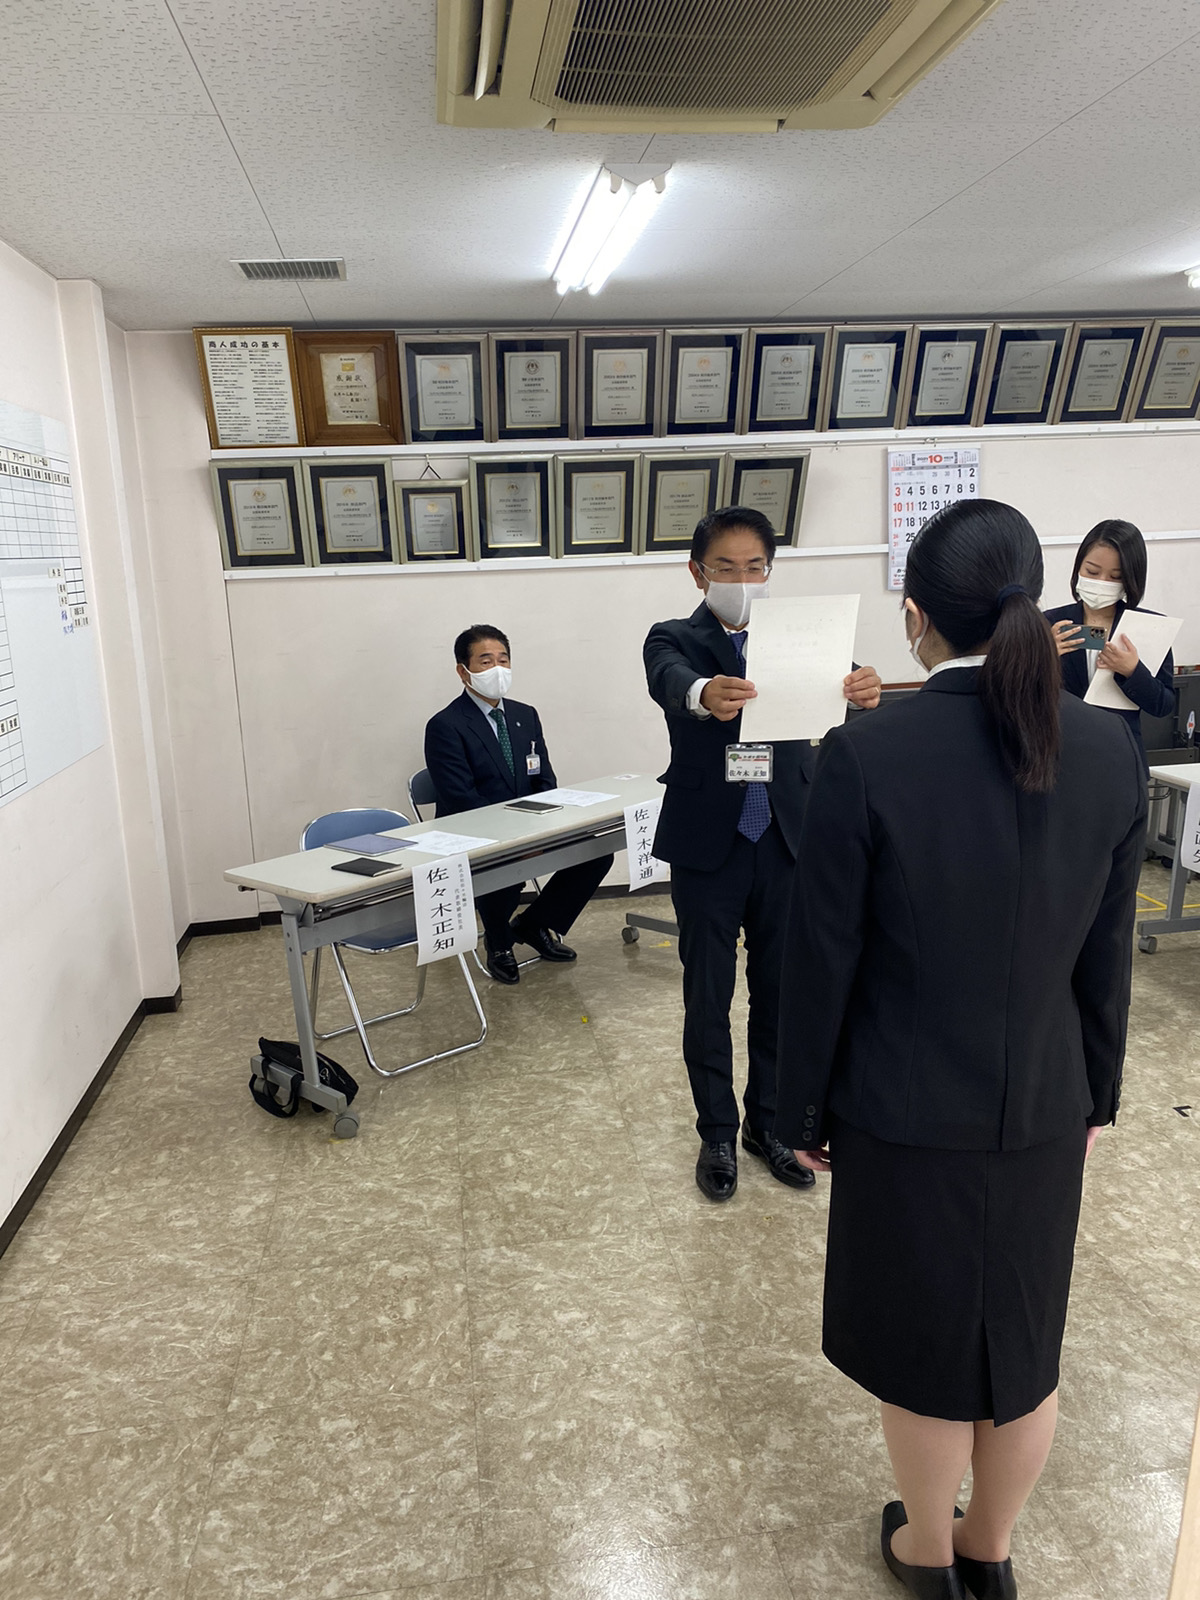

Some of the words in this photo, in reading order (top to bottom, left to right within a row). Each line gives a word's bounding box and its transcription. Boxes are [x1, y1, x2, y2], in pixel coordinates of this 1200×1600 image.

[208, 340, 280, 349] 商人成功の基本
[928, 454, 943, 463] 10
[957, 468, 962, 478] 1
[969, 467, 975, 477] 2
[895, 486, 901, 497] 3
[907, 486, 913, 496] 4
[919, 485, 925, 495] 5
[932, 485, 938, 495] 6
[944, 484, 950, 494] 7
[957, 483, 963, 493] 8
[969, 483, 975, 493] 9
[893, 502, 902, 512] 10
[906, 501, 914, 511] 11
[918, 501, 927, 511] 12
[931, 500, 940, 510] 13
[893, 518, 902, 528] 17
[906, 517, 915, 527] 18
[634, 808, 653, 881] 佐々木洋通
[426, 867, 455, 954] 佐々木正知
